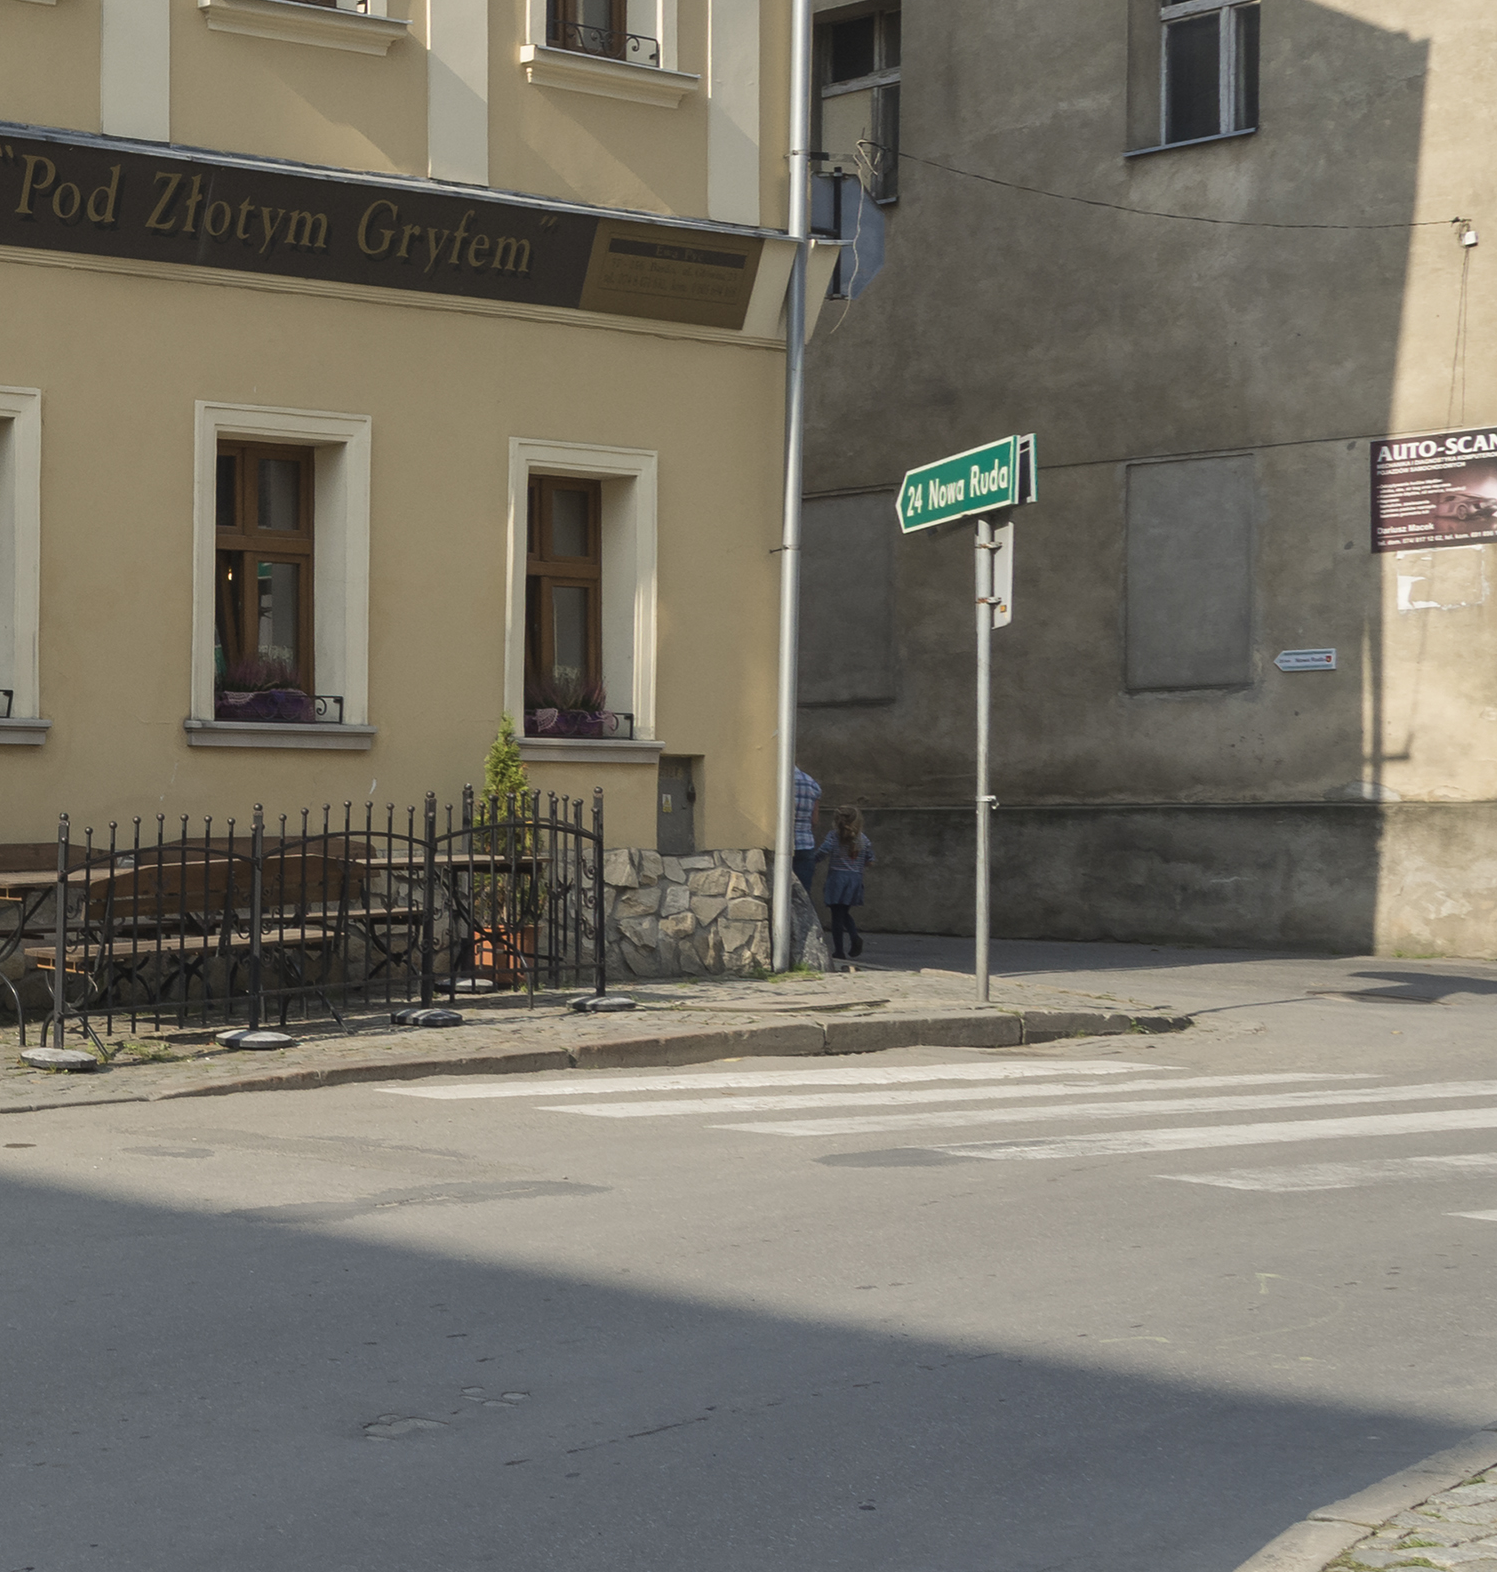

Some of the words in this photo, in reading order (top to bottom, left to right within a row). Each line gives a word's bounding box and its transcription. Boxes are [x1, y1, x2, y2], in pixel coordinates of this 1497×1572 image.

[146, 170, 328, 256] Złotym
[907, 483, 923, 517] 24
[928, 478, 965, 511] Nowa
[970, 458, 1009, 498] Ruda
